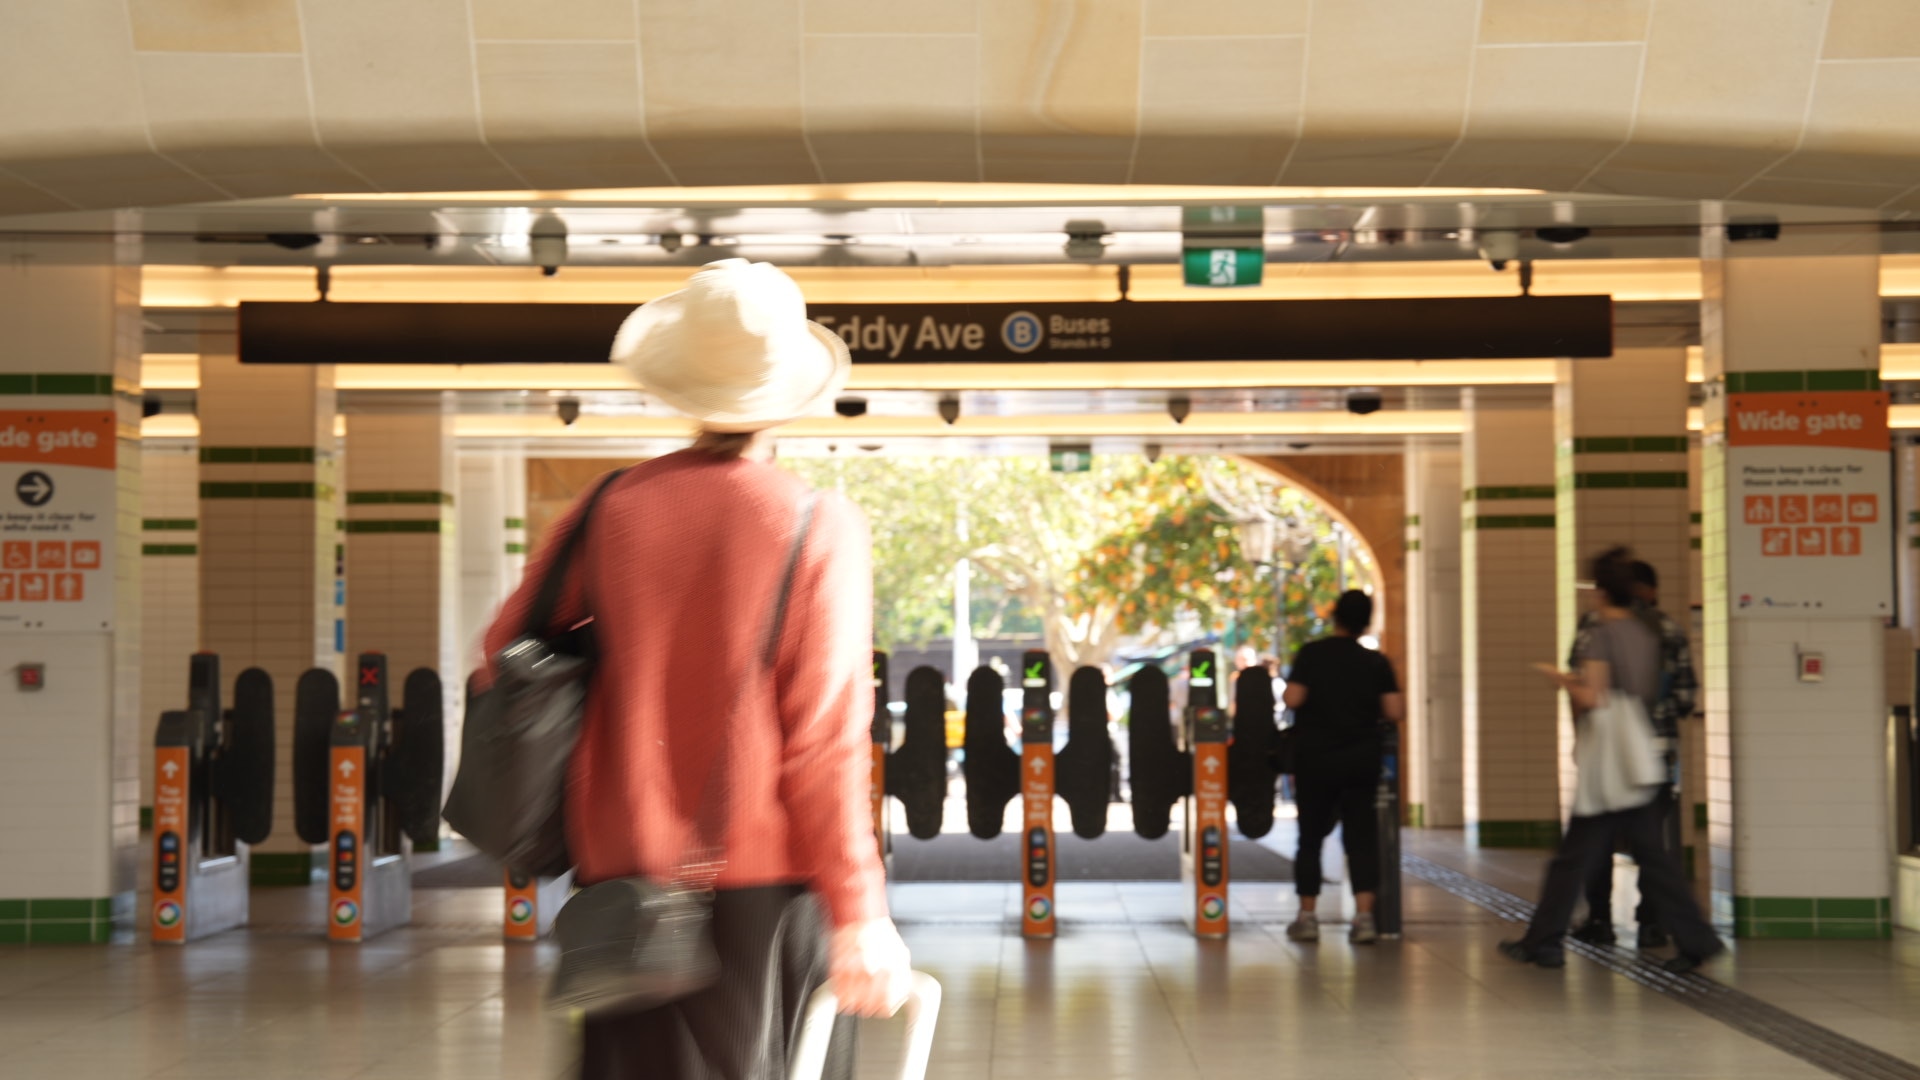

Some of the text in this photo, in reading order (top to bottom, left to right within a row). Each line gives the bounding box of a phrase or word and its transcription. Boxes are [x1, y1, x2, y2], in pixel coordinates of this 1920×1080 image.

[815, 315, 985, 359] ddy Ave
[1050, 314, 1110, 335] Buses
[1737, 409, 1863, 435] Wide gate
[37, 427, 98, 453] gate
